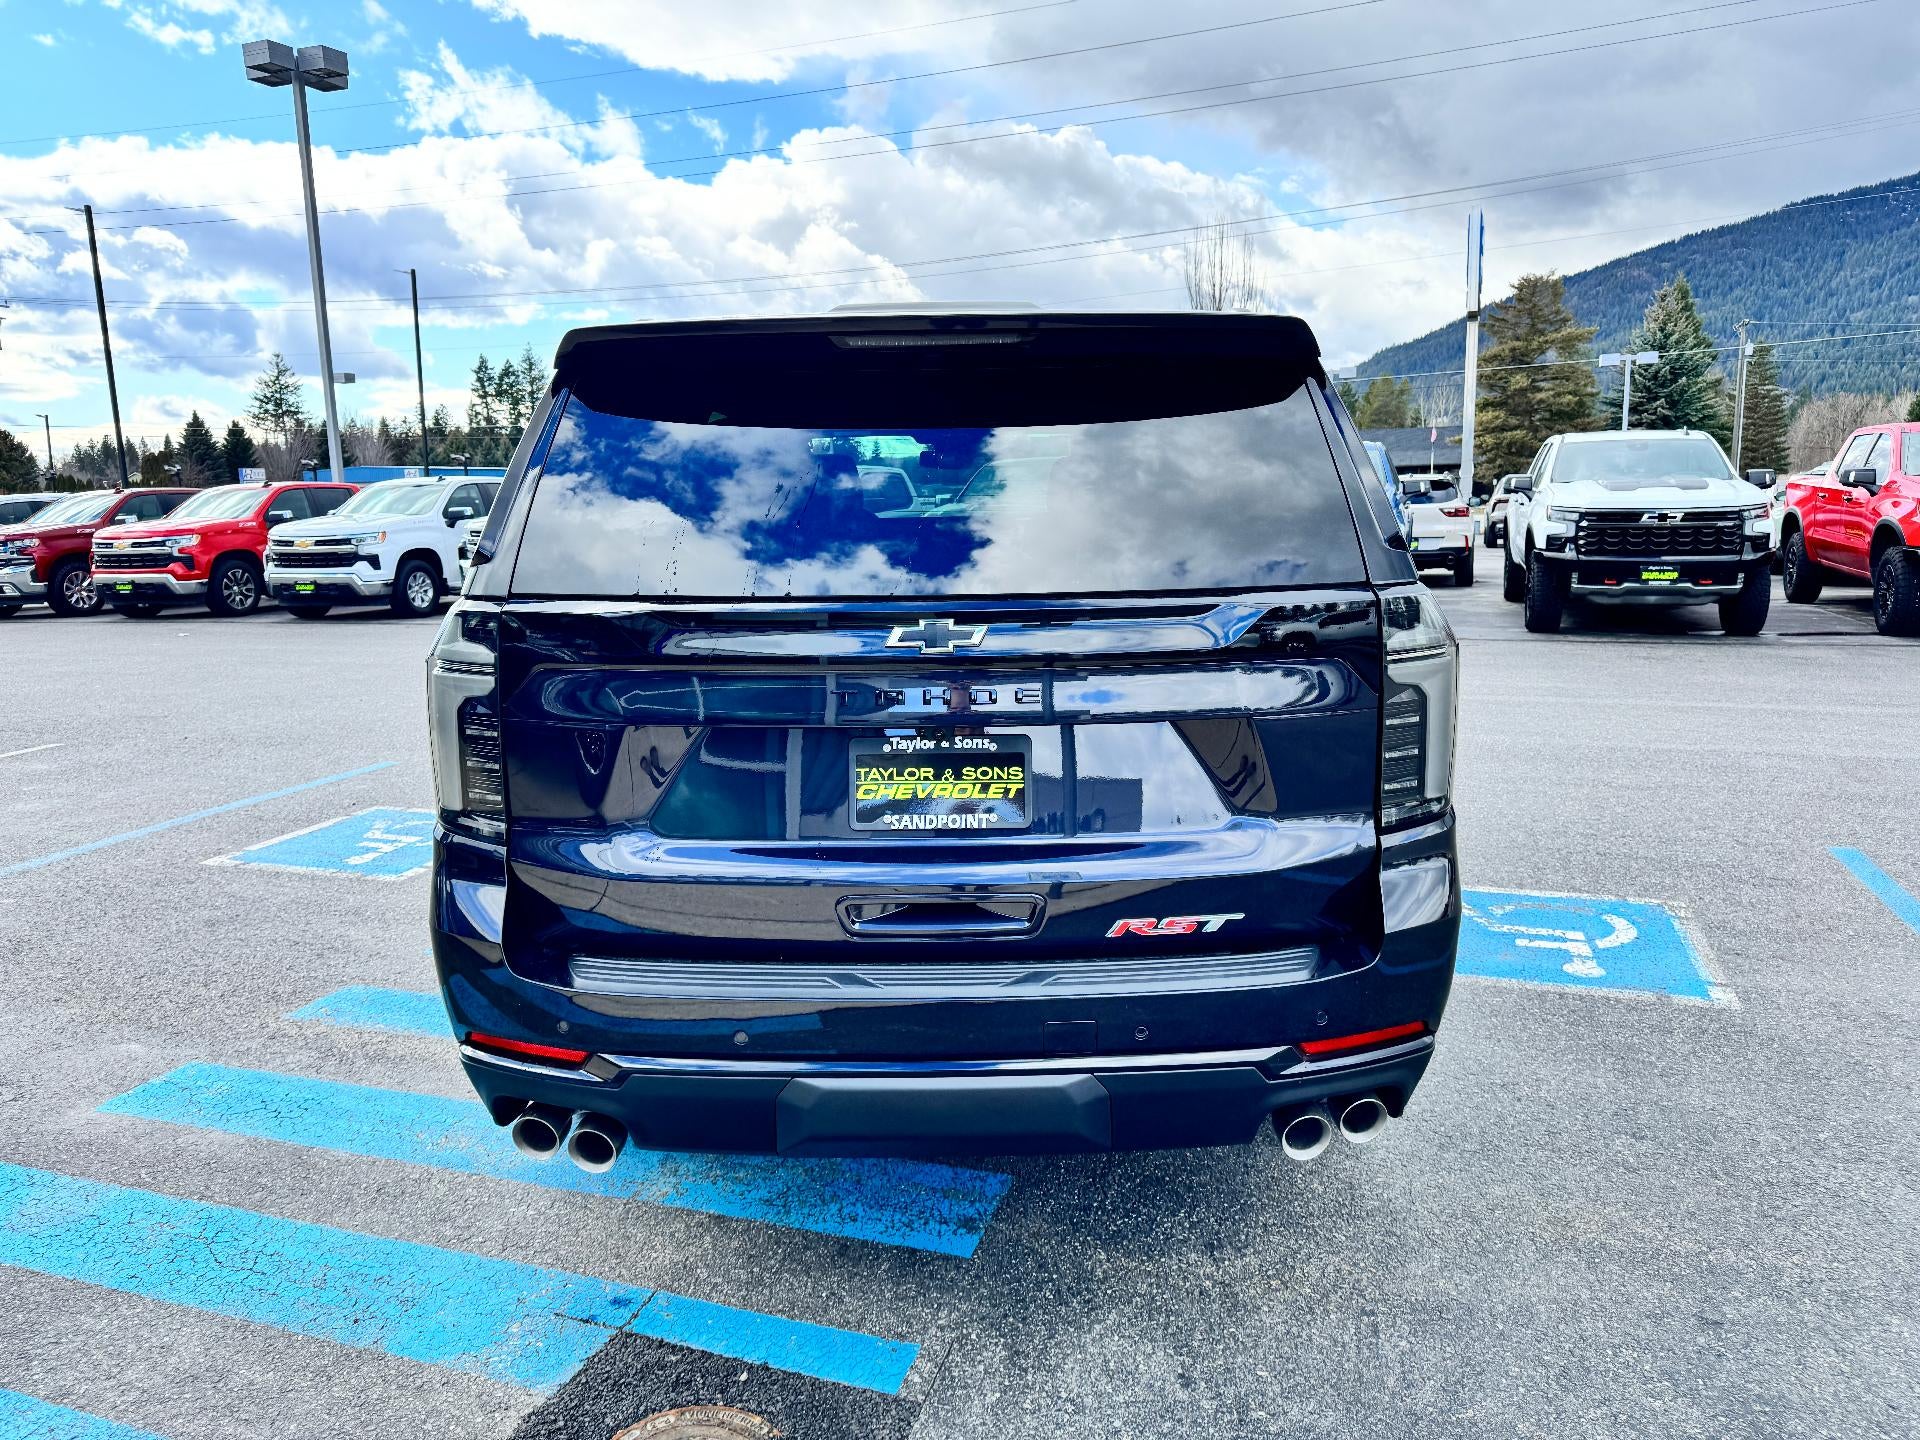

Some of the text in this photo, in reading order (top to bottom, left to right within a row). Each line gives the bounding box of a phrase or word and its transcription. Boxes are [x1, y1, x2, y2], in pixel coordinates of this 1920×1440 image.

[890, 737, 936, 753] Taylor
[953, 736, 990, 749] Sons
[856, 767, 1023, 783] TAYLOR & SONS
[856, 783, 1024, 800] CHEVROLET
[890, 814, 989, 830] SANDPOINT
[1105, 912, 1245, 937] RST
